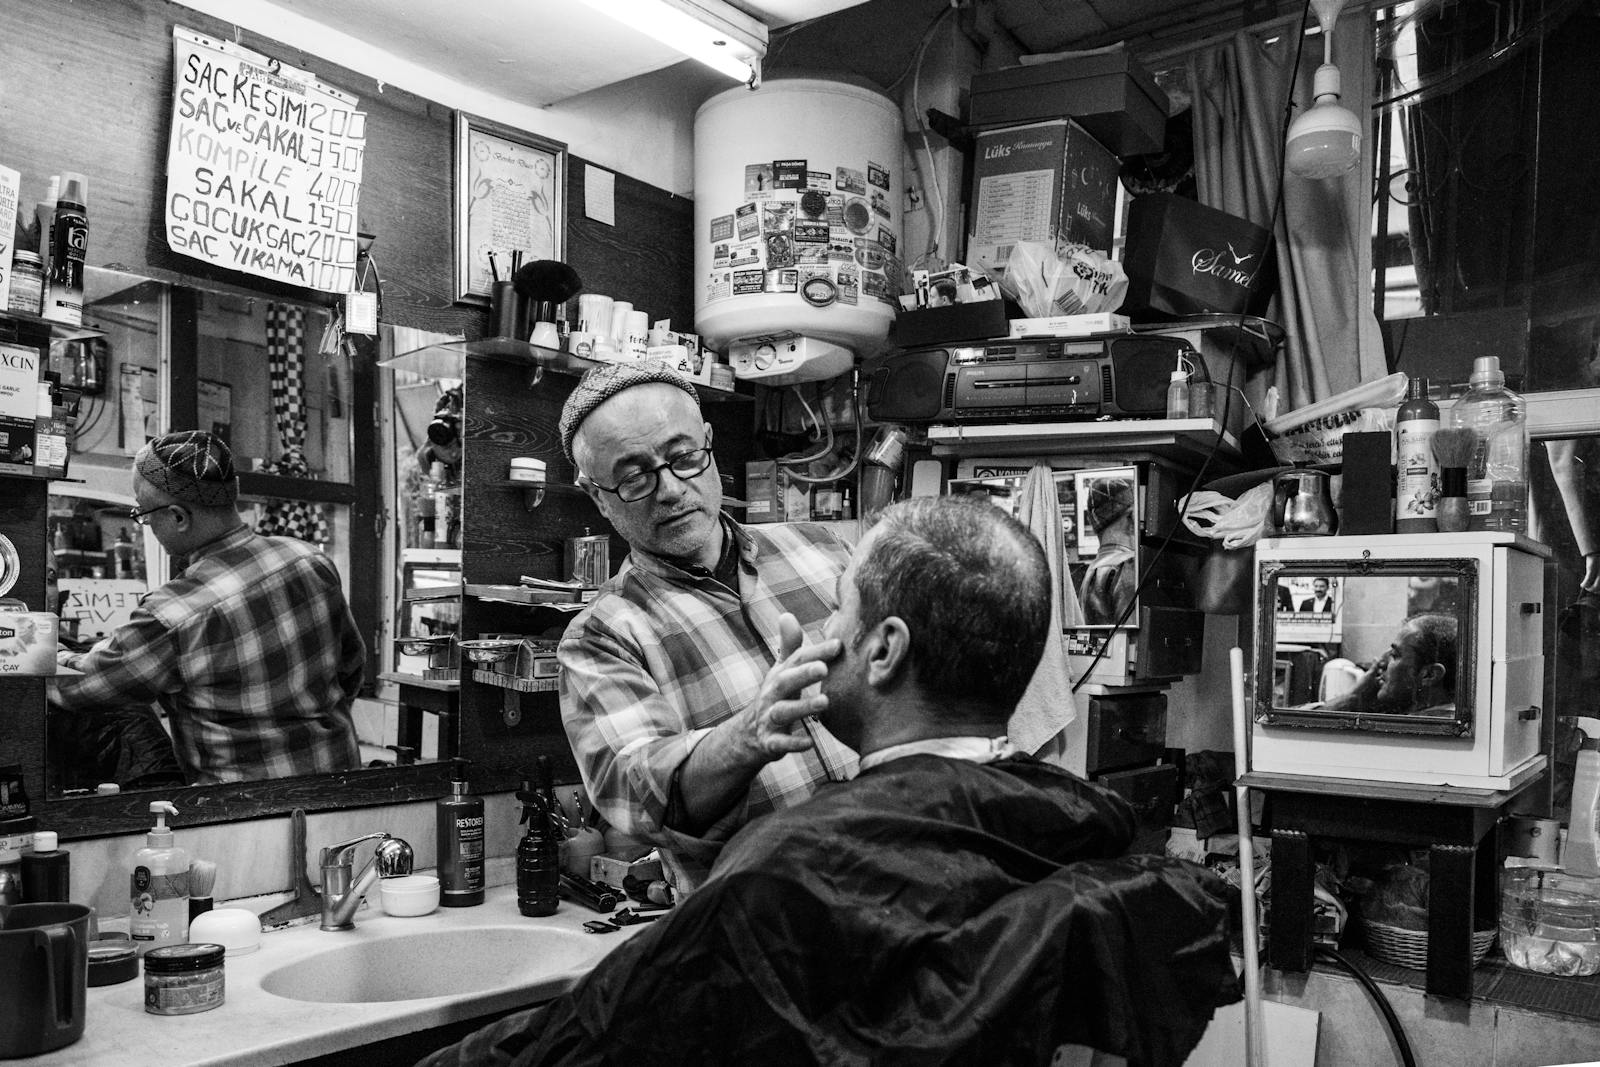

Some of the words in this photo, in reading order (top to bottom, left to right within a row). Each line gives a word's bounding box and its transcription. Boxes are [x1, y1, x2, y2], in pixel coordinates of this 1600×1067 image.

[184, 53, 228, 99] SAÇ
[308, 101, 366, 139] 200
[179, 87, 229, 134] SAÇ
[241, 113, 307, 164] SAKAL
[308, 135, 359, 173] 350
[985, 144, 1011, 159] Lüks
[194, 167, 302, 224] SAKAL
[307, 202, 352, 234] 150
[307, 171, 357, 207] 400
[170, 225, 219, 259] SAÇ
[307, 259, 355, 294] 100
[306, 229, 356, 264] 200
[2, 663, 20, 673] ÇAY
